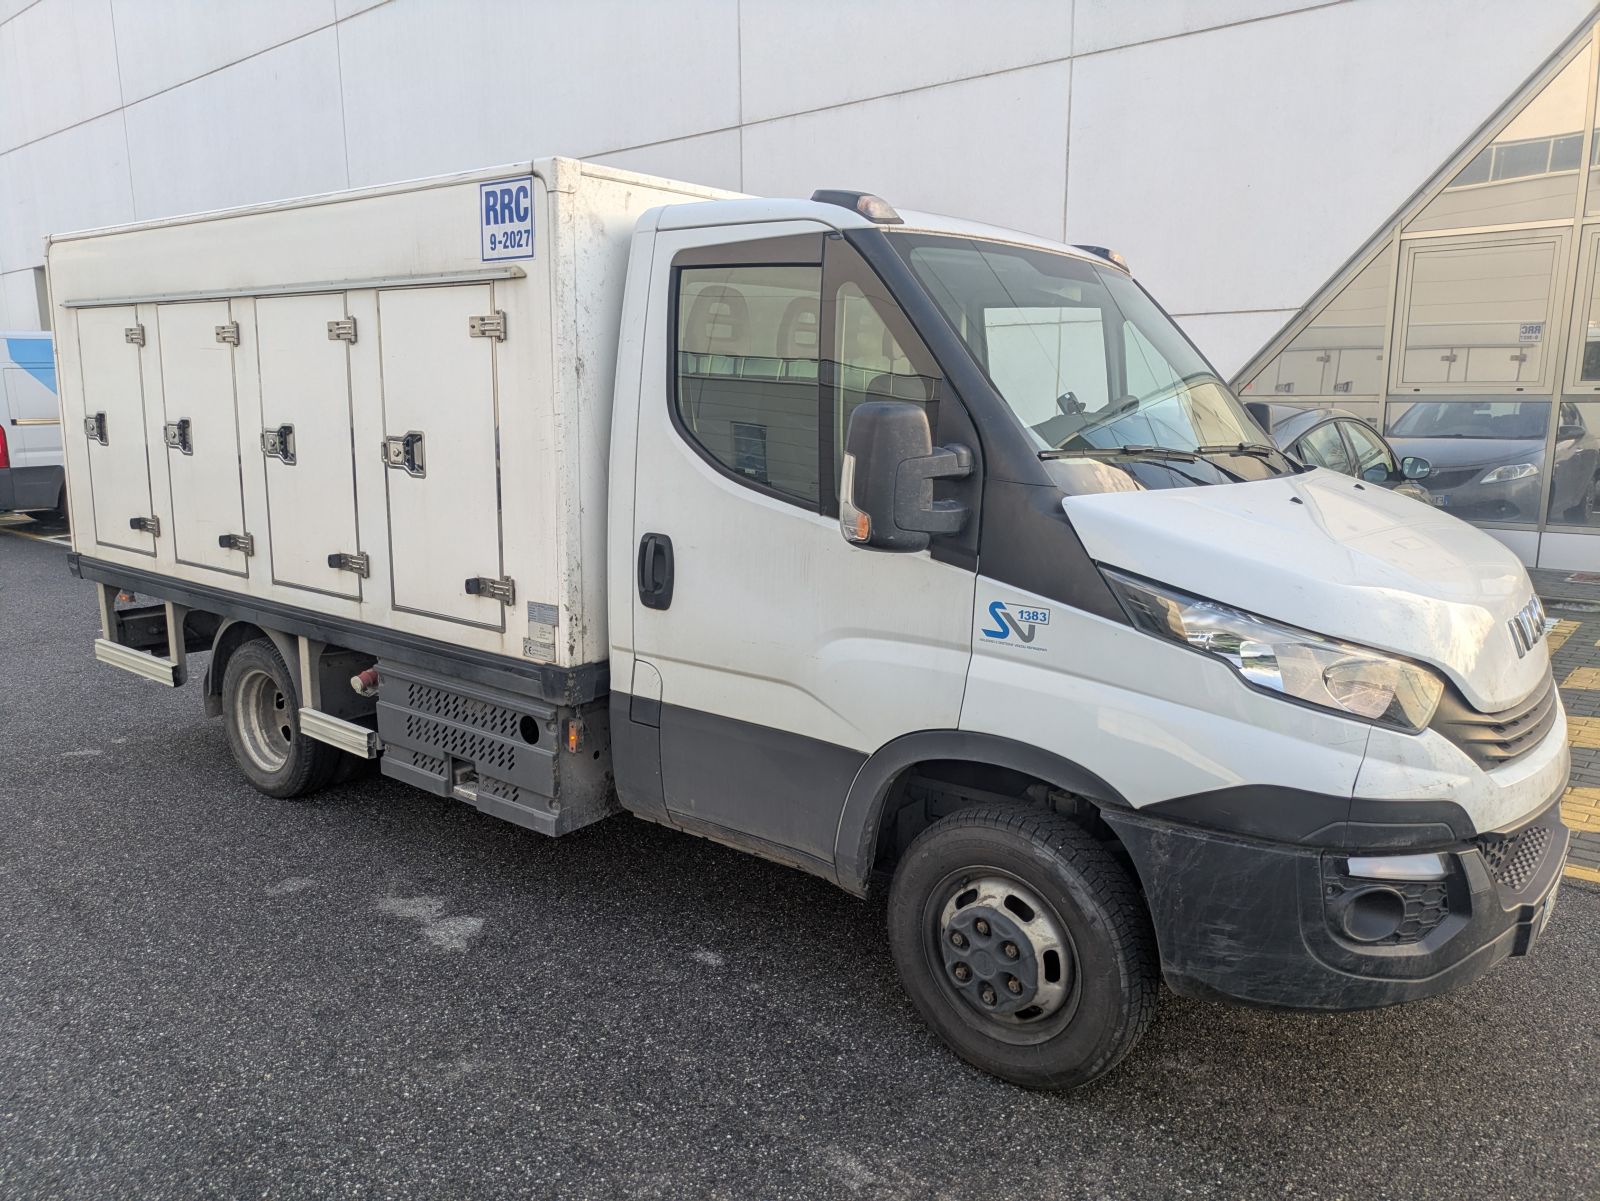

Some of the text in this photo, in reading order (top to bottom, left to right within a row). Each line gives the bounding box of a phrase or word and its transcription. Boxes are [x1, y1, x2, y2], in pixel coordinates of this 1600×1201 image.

[485, 186, 529, 226] RRC
[490, 229, 531, 251] 9-2027
[1018, 609, 1047, 622] 1383
